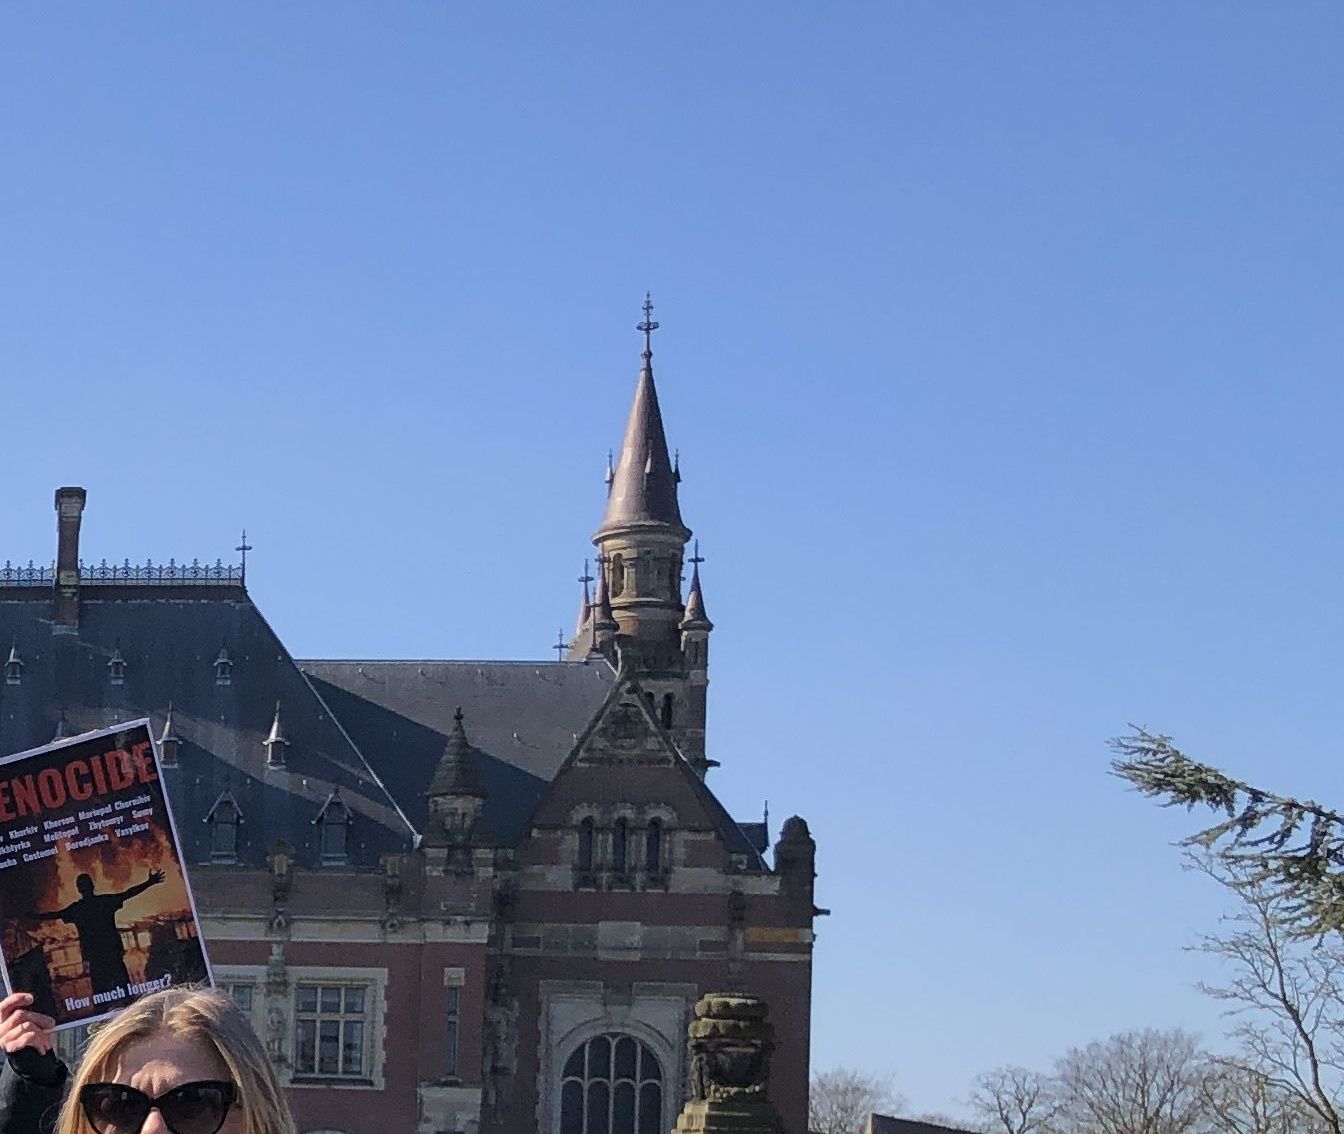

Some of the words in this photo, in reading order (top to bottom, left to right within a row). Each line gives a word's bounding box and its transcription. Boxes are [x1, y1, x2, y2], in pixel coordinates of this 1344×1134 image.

[9, 825, 39, 840] Kharkiv
[43, 815, 75, 831] Kherson
[64, 996, 90, 1011] How
[93, 985, 126, 1005] much
[127, 973, 172, 996] longer?
